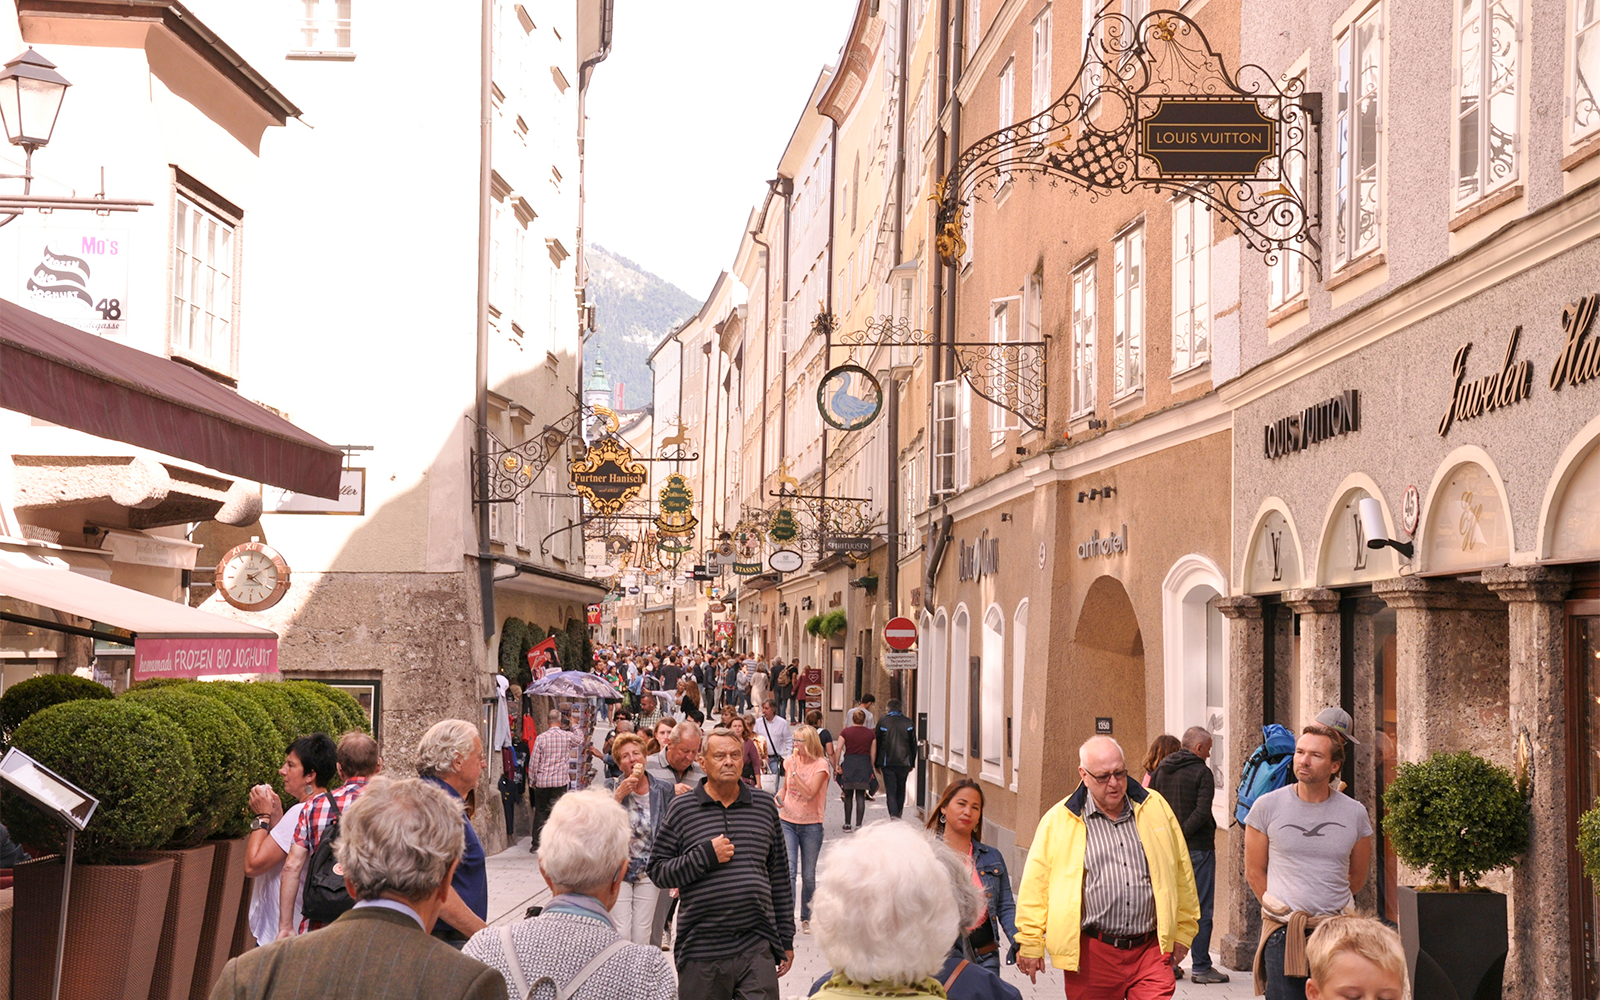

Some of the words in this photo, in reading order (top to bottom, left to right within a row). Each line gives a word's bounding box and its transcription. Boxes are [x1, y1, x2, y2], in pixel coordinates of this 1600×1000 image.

[1156, 132, 1198, 144] LOUIS
[1201, 132, 1262, 144] VUITTON
[95, 299, 121, 320] 48
[1438, 325, 1530, 436] Juwelen
[1299, 389, 1360, 452] VUITTON
[574, 473, 607, 483] Furtner
[609, 473, 643, 484] Hanisch
[1077, 523, 1127, 559] arthotel
[174, 648, 214, 671] FROZEN
[217, 649, 232, 669] BIO
[232, 647, 273, 668] JOGHURT
